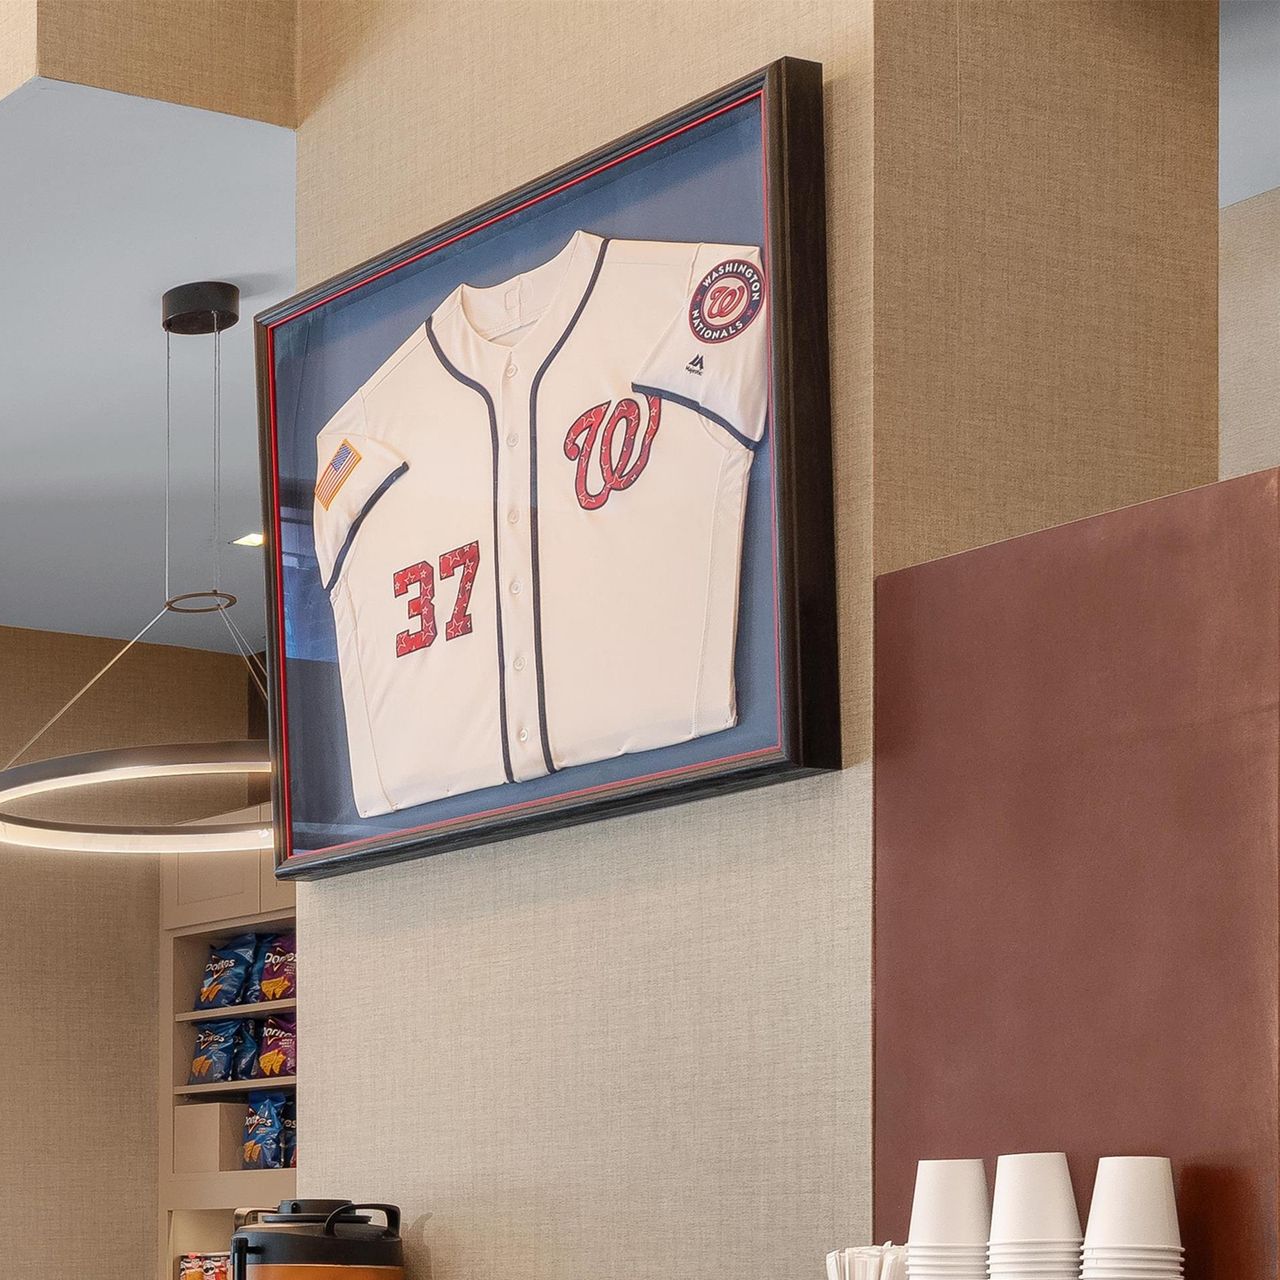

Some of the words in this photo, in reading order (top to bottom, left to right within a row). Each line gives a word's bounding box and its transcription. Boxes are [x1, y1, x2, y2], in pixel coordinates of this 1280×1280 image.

[703, 262, 760, 301] WASHINGTON
[692, 308, 743, 339] NATIONALS
[393, 540, 480, 658] 37
